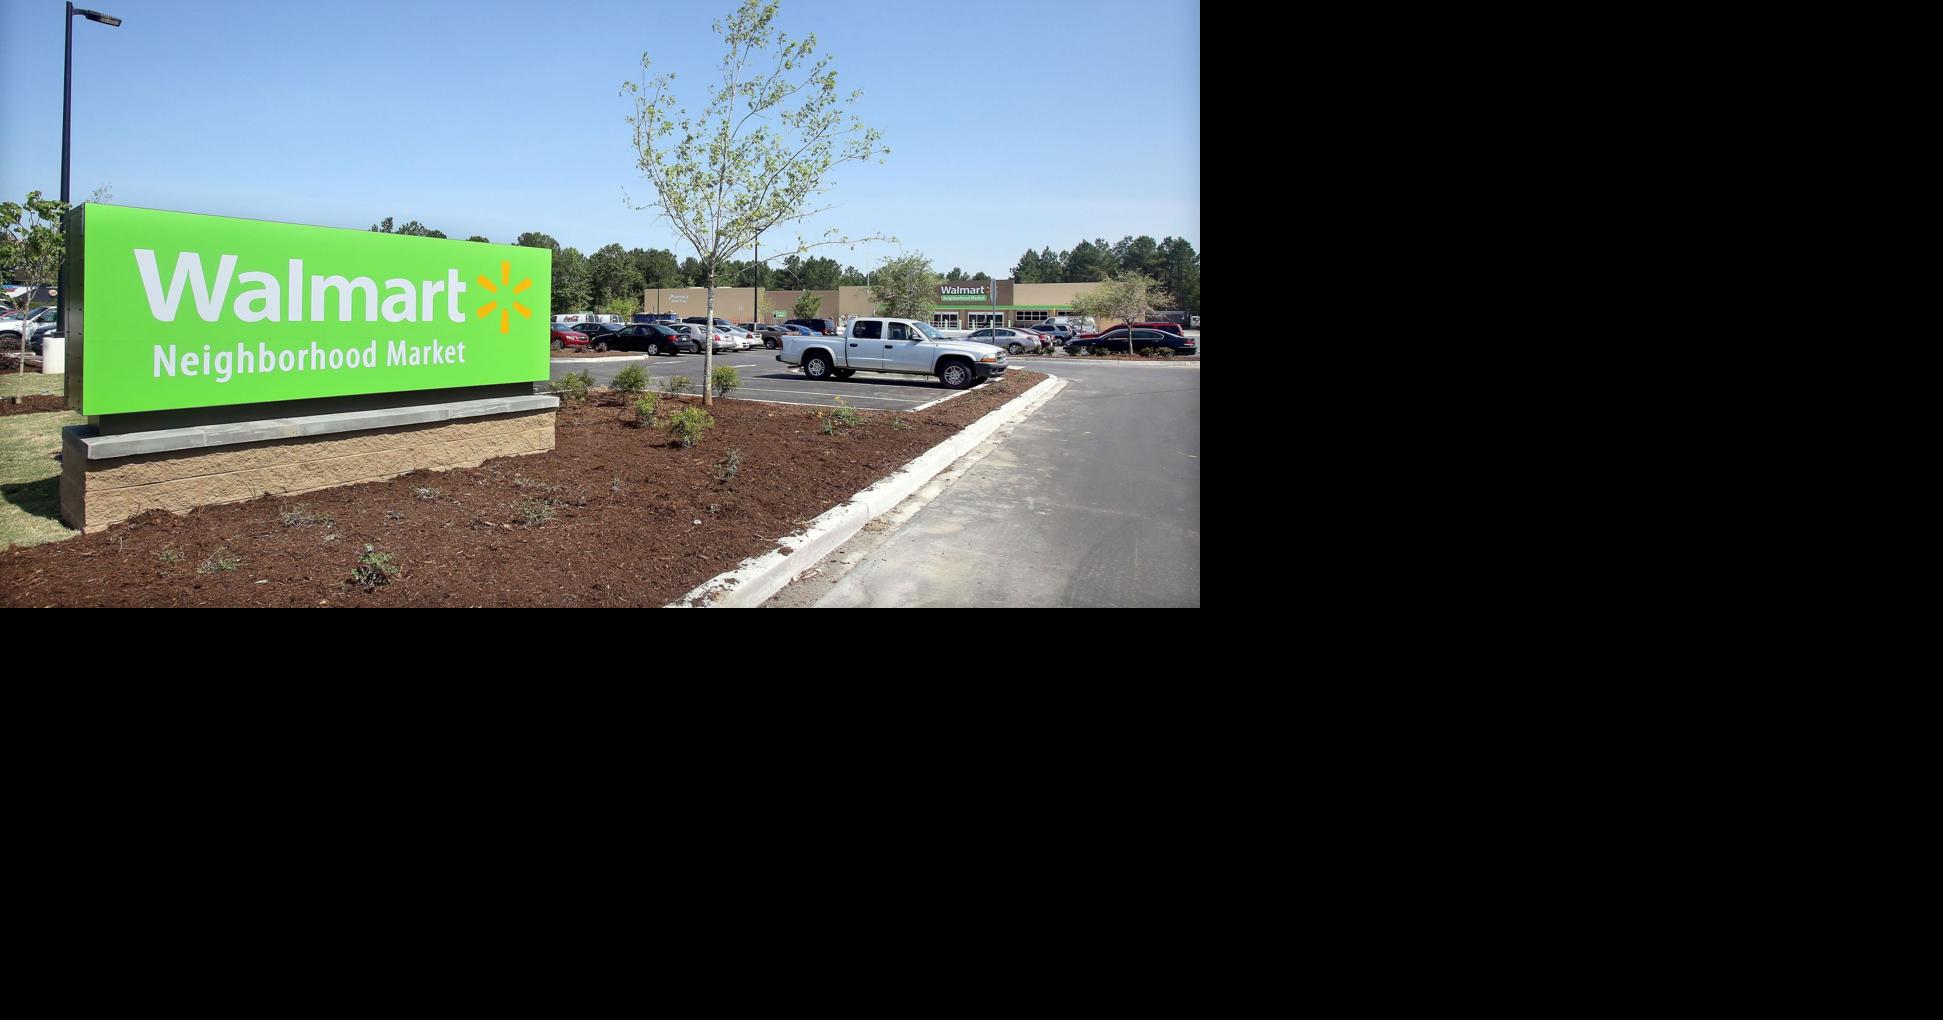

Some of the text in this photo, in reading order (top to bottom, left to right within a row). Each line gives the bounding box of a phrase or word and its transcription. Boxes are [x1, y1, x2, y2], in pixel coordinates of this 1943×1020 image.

[134, 249, 467, 322] Walmart
[941, 286, 984, 294] Walmart
[154, 339, 466, 383] Neighborhood Market
